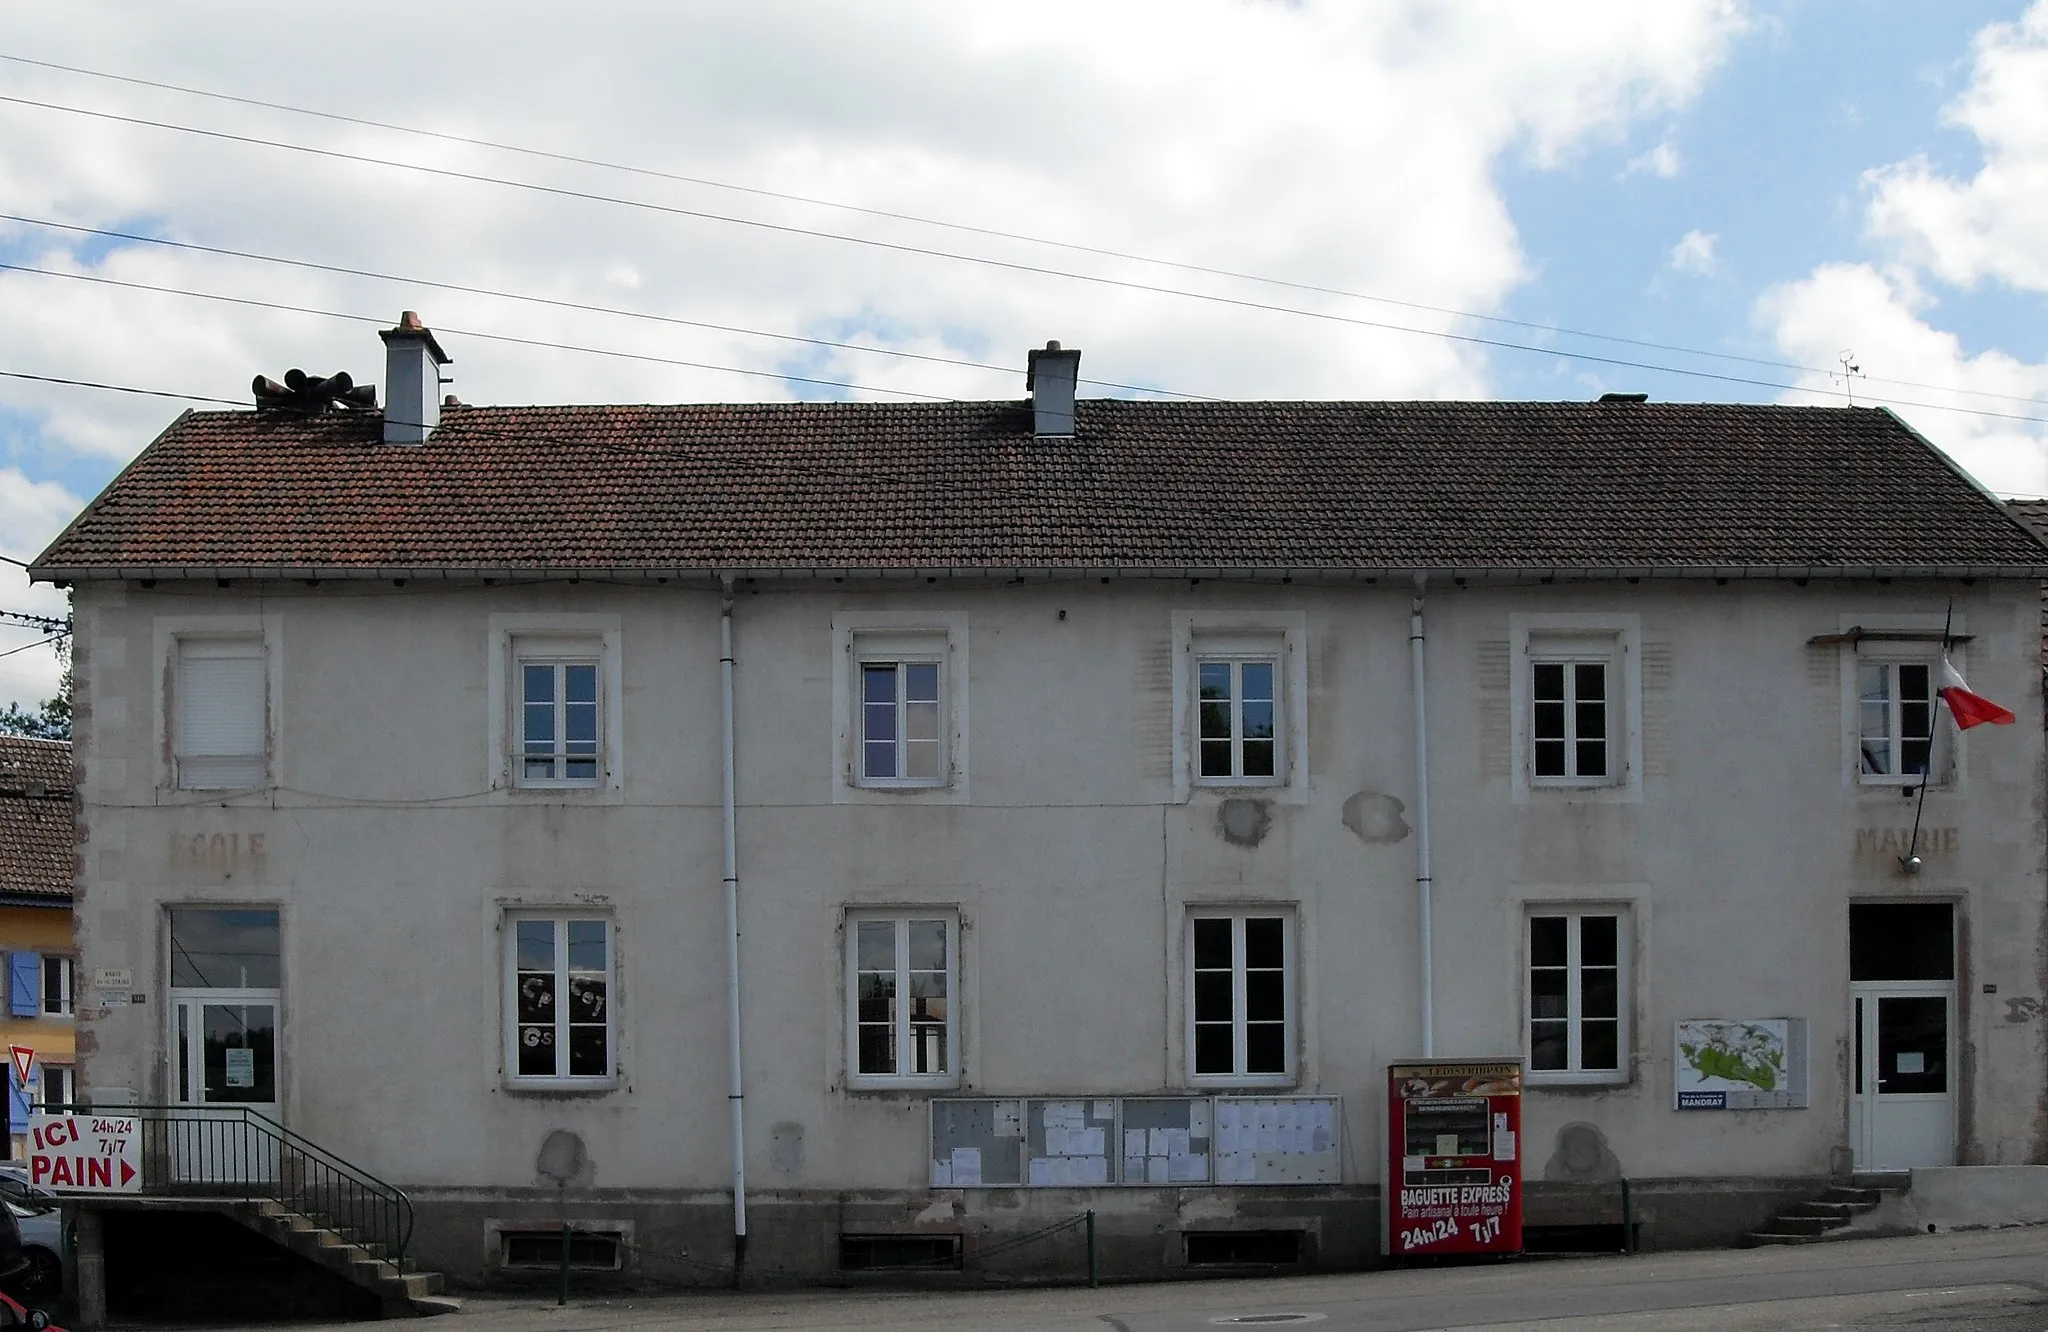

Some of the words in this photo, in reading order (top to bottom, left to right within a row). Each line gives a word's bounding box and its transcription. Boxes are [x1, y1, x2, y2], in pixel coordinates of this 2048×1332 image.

[33, 1118, 79, 1151] ICI
[92, 1119, 132, 1134] 24h/24
[99, 1139, 126, 1156] 7j/7
[32, 1155, 112, 1187] PAIN
[1401, 1187, 1458, 1206] BAGUETTE
[1461, 1186, 1510, 1204] EXPRESS
[1401, 1206, 1419, 1218] Pain
[1420, 1205, 1452, 1218] artisanal
[1460, 1204, 1480, 1217] toute
[1481, 1203, 1503, 1216] heure
[1401, 1217, 1459, 1250] 24h/24
[1469, 1215, 1501, 1244] 7j/7
